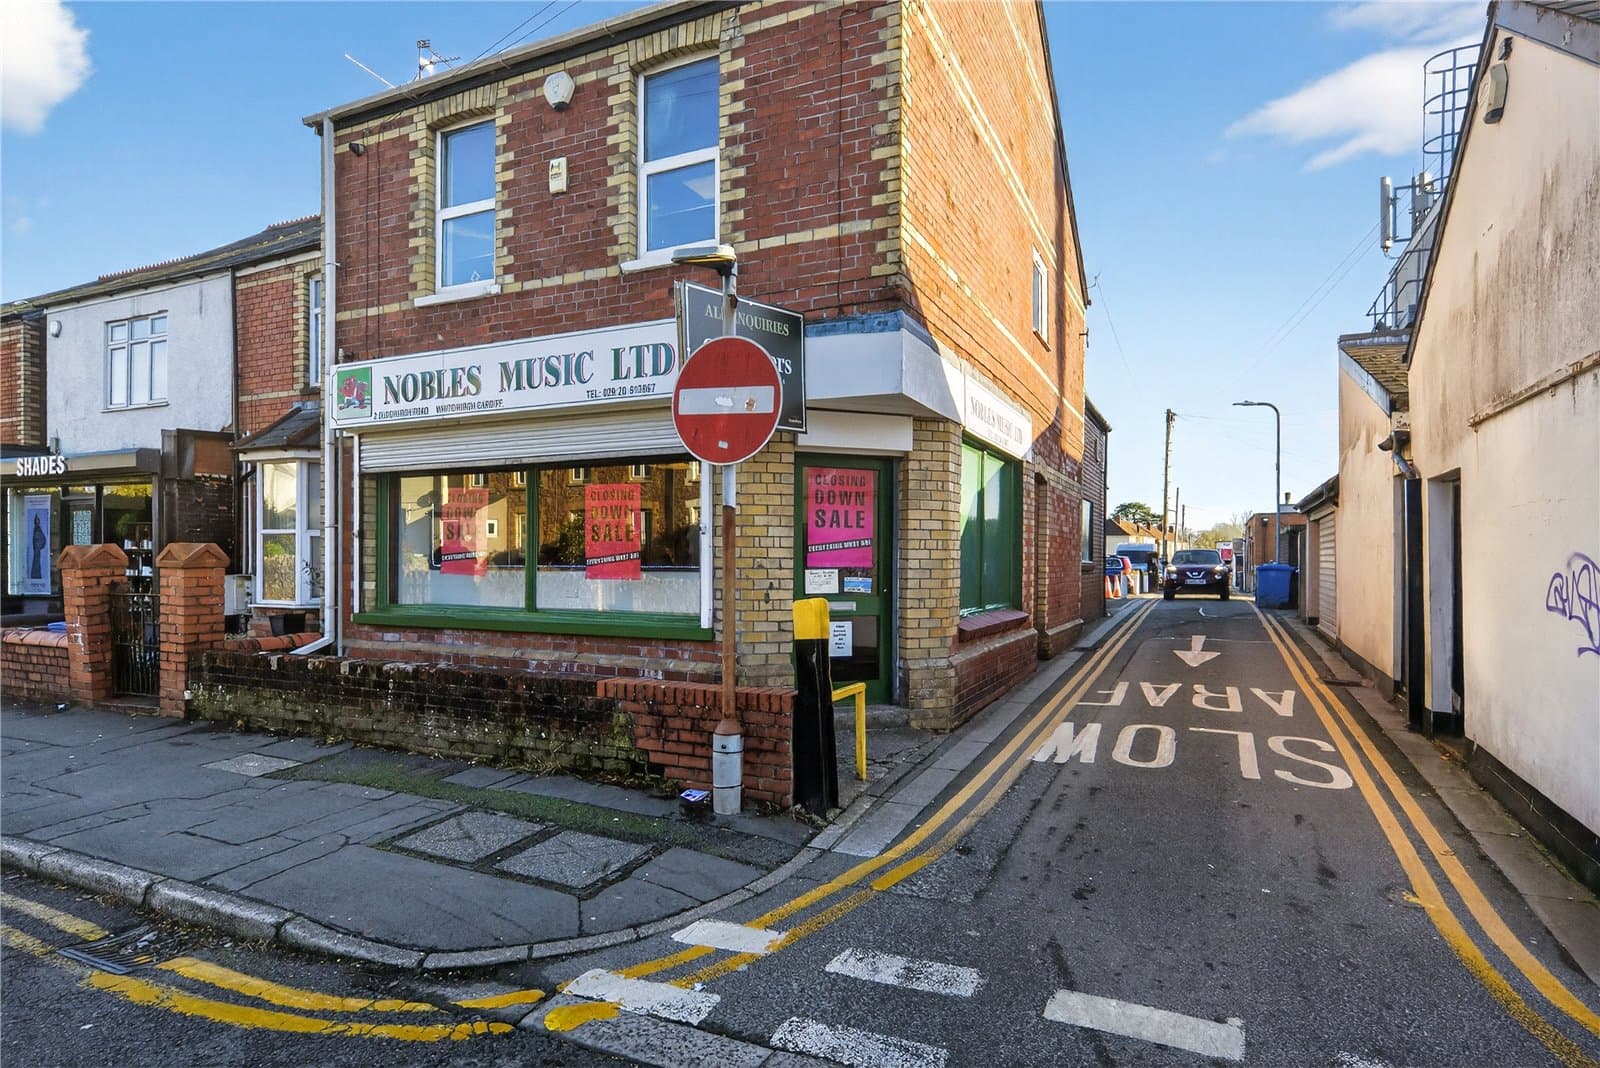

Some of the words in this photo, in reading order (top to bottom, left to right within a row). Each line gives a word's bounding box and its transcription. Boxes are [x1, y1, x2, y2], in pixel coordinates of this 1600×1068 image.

[705, 303, 724, 322] AL
[736, 312, 790, 337] NQUIRIES
[383, 364, 482, 406] NOBLES
[499, 350, 595, 393] MUSIC
[611, 341, 677, 382] LTD
[618, 386, 627, 396] 20
[16, 455, 66, 477] SHADES
[815, 473, 866, 487] CLOSING
[591, 488, 635, 501] CLOSING
[815, 489, 865, 506] DOWN
[591, 504, 633, 520] DOWN
[814, 509, 865, 529] SALE
[591, 523, 634, 542] SALE
[1076, 680, 1297, 717] ARAF
[1031, 721, 1354, 790] SLOW
